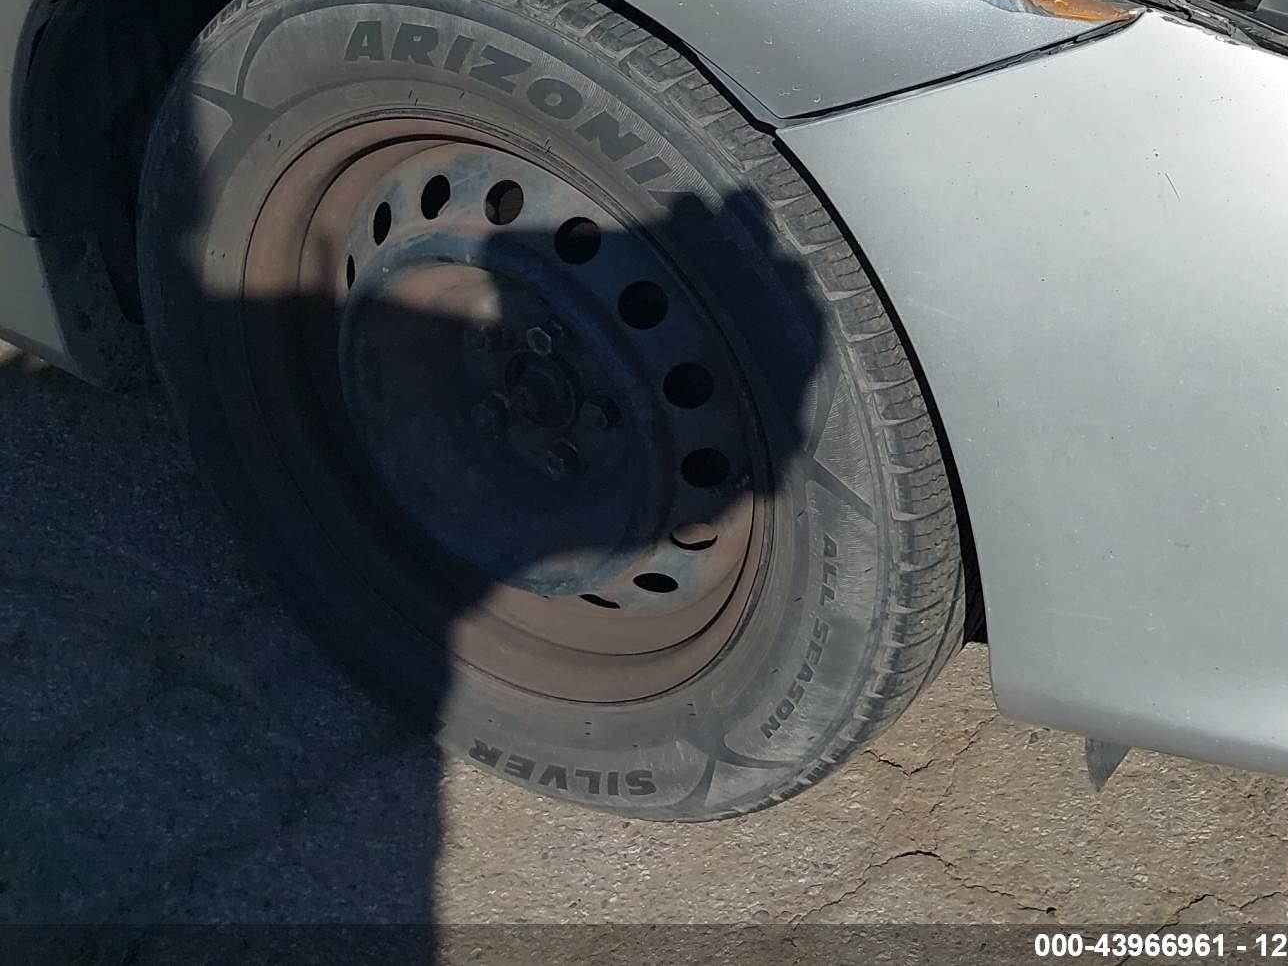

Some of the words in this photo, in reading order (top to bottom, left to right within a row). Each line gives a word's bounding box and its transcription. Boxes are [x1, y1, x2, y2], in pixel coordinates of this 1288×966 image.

[343, 19, 692, 208] ARIZONI
[821, 534, 838, 607] ALL
[760, 617, 829, 739] SEASON
[468, 738, 657, 797] SILVER
